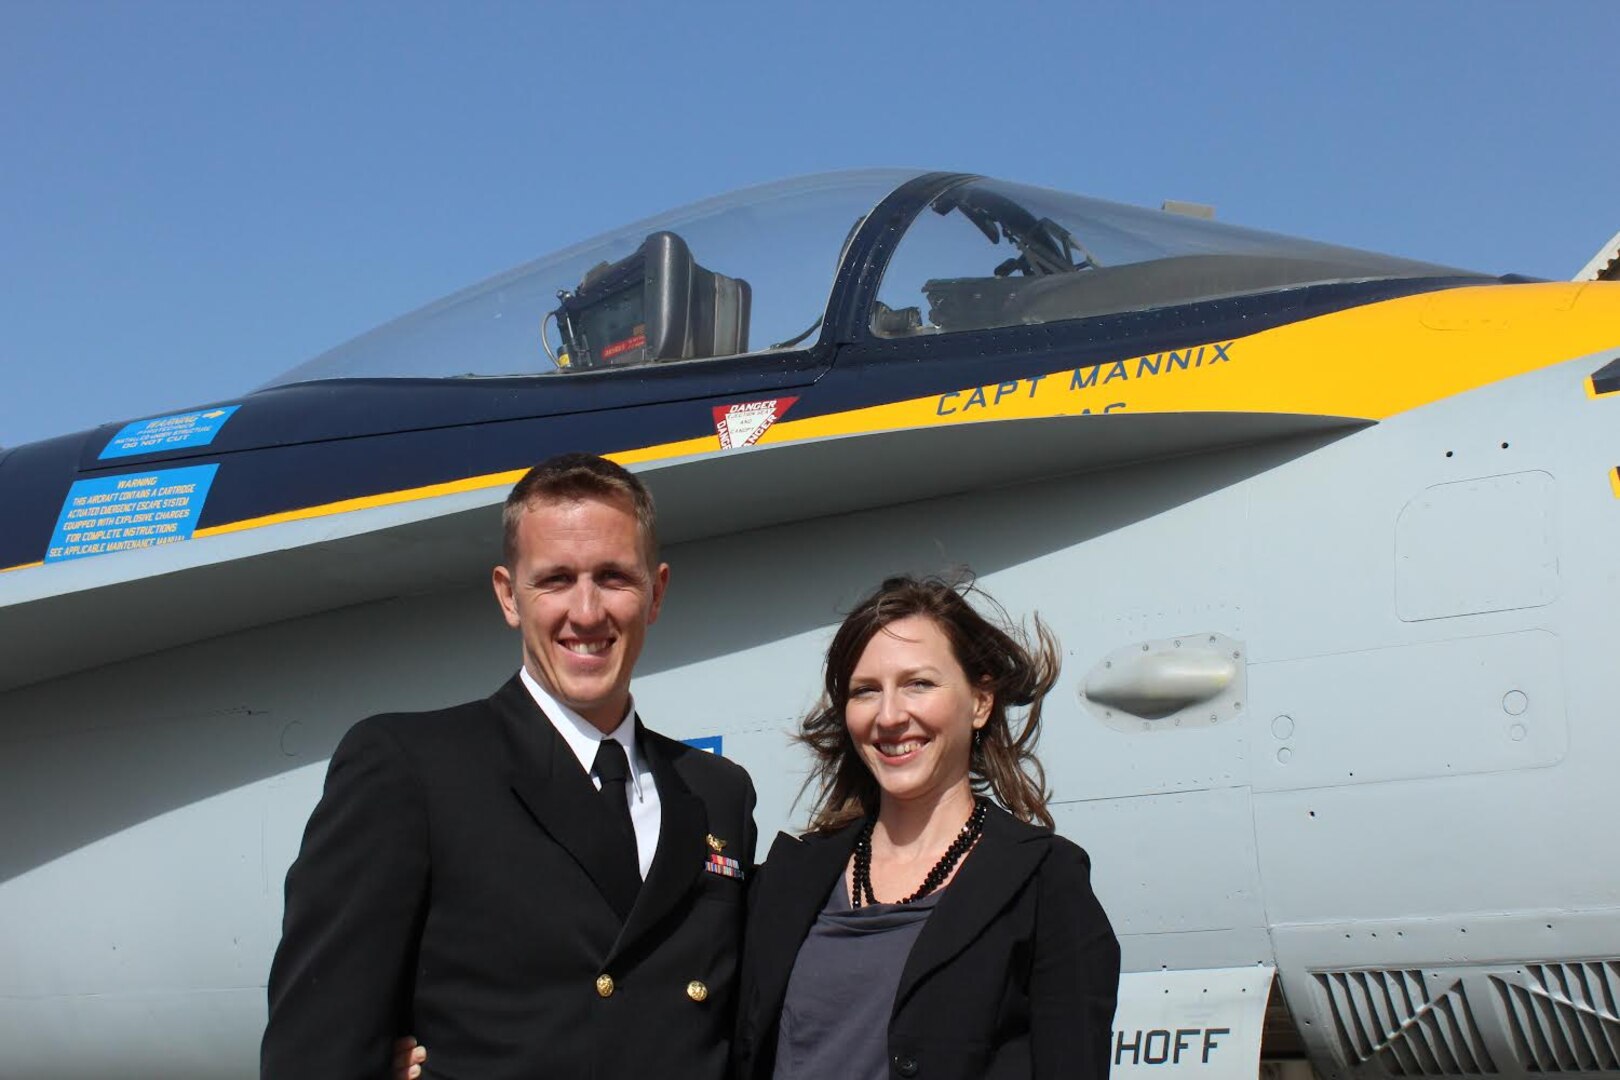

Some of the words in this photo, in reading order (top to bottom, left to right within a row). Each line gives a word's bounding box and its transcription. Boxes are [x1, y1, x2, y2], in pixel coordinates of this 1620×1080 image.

[936, 375, 1047, 416] CAPT
[1069, 341, 1235, 391] MANNIX
[729, 400, 777, 413] DANGER
[121, 441, 138, 449] DO
[140, 438, 163, 447] NOT
[166, 434, 191, 443] CUT
[117, 476, 158, 489] WARNING
[73, 497, 88, 507] THIS
[86, 491, 119, 505] AIRCRAFT
[118, 488, 150, 500] CONTAINS
[151, 487, 157, 496] A
[158, 483, 197, 497] CARTRIDGE
[67, 507, 100, 519] ACTUATED
[99, 502, 136, 516] EMERGENCY
[136, 499, 163, 511] ESCAPE
[162, 497, 190, 508] SYSTEM
[63, 519, 97, 531] EQUIPPED
[97, 516, 115, 526] WITH
[115, 512, 154, 525] EXPLOSIVE
[154, 509, 191, 518] CHARGES
[65, 532, 83, 543] FOR
[83, 527, 123, 541] COMPLETE
[123, 523, 178, 537] INSTRUCTIONS
[49, 547, 64, 558] SEE
[63, 541, 108, 556] APPLICABLE
[106, 538, 157, 552] MAINTENANCE
[1111, 1028, 1231, 1066] HOFF
